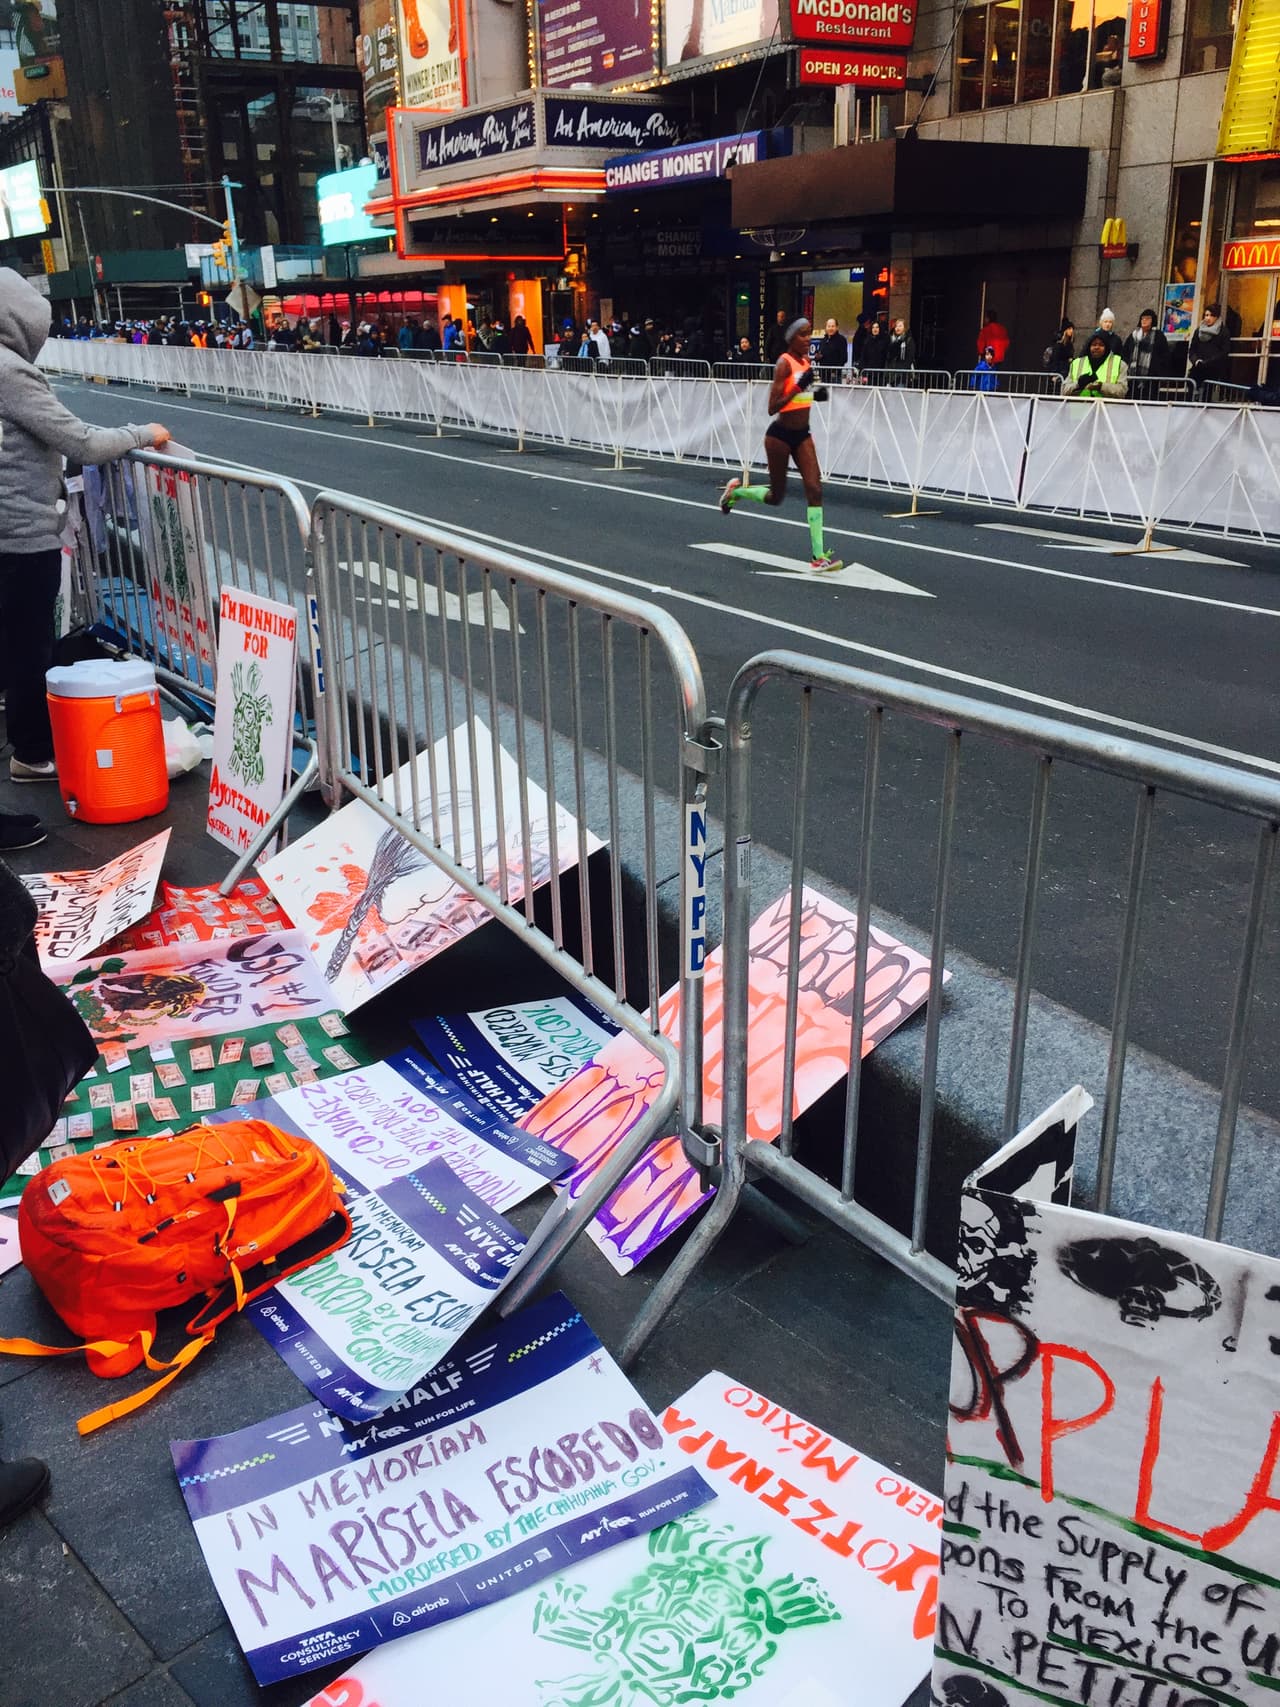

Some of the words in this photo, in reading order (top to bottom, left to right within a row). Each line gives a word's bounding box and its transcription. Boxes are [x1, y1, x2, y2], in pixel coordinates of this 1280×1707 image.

[798, 0, 912, 24] McDonald's
[816, 20, 892, 38] Restaurant
[805, 61, 841, 76] OPEN
[844, 63, 859, 75] 24
[553, 108, 574, 138] An
[576, 106, 644, 147] American
[646, 112, 681, 146] Paris
[605, 160, 660, 187] CHANGE
[662, 150, 714, 179] MONEY
[237, 599, 296, 642] RUNNING
[243, 631, 269, 660] FOR
[690, 810, 707, 972] NYPD
[226, 933, 306, 988] USA
[174, 956, 242, 1023] FUNDER
[466, 1061, 501, 1094] HALF
[393, 1093, 440, 1123] GOV.
[460, 1106, 486, 1126] UNITED
[367, 1151, 410, 1174] OF
[365, 1196, 383, 1212] IN
[371, 1208, 427, 1253] MEMORIAM
[463, 1227, 501, 1259] NYC
[486, 1219, 516, 1246] UNITED
[345, 1310, 383, 1336] THE
[374, 1302, 400, 1319] BY
[293, 1340, 322, 1372] UNITED
[392, 1370, 464, 1413] HALF
[413, 1416, 435, 1429] RUN
[435, 1409, 457, 1422] FOR
[456, 1399, 477, 1413] LIFE
[485, 1407, 665, 1518] ESCOBEDO
[485, 1522, 512, 1548] BY
[514, 1506, 547, 1536] THE
[621, 1459, 666, 1488] GOV.
[974, 1489, 1044, 1539] the
[411, 1596, 450, 1618] airbnb
[475, 1558, 535, 1591] UNITED
[639, 1506, 656, 1520] RUN
[655, 1499, 672, 1512] FOR
[670, 1490, 689, 1505] LIFE
[279, 1629, 361, 1663] CONSULTANCY
[299, 1630, 336, 1648] TATA
[1150, 1608, 1223, 1655] the
[298, 1642, 352, 1667] SERVICES
